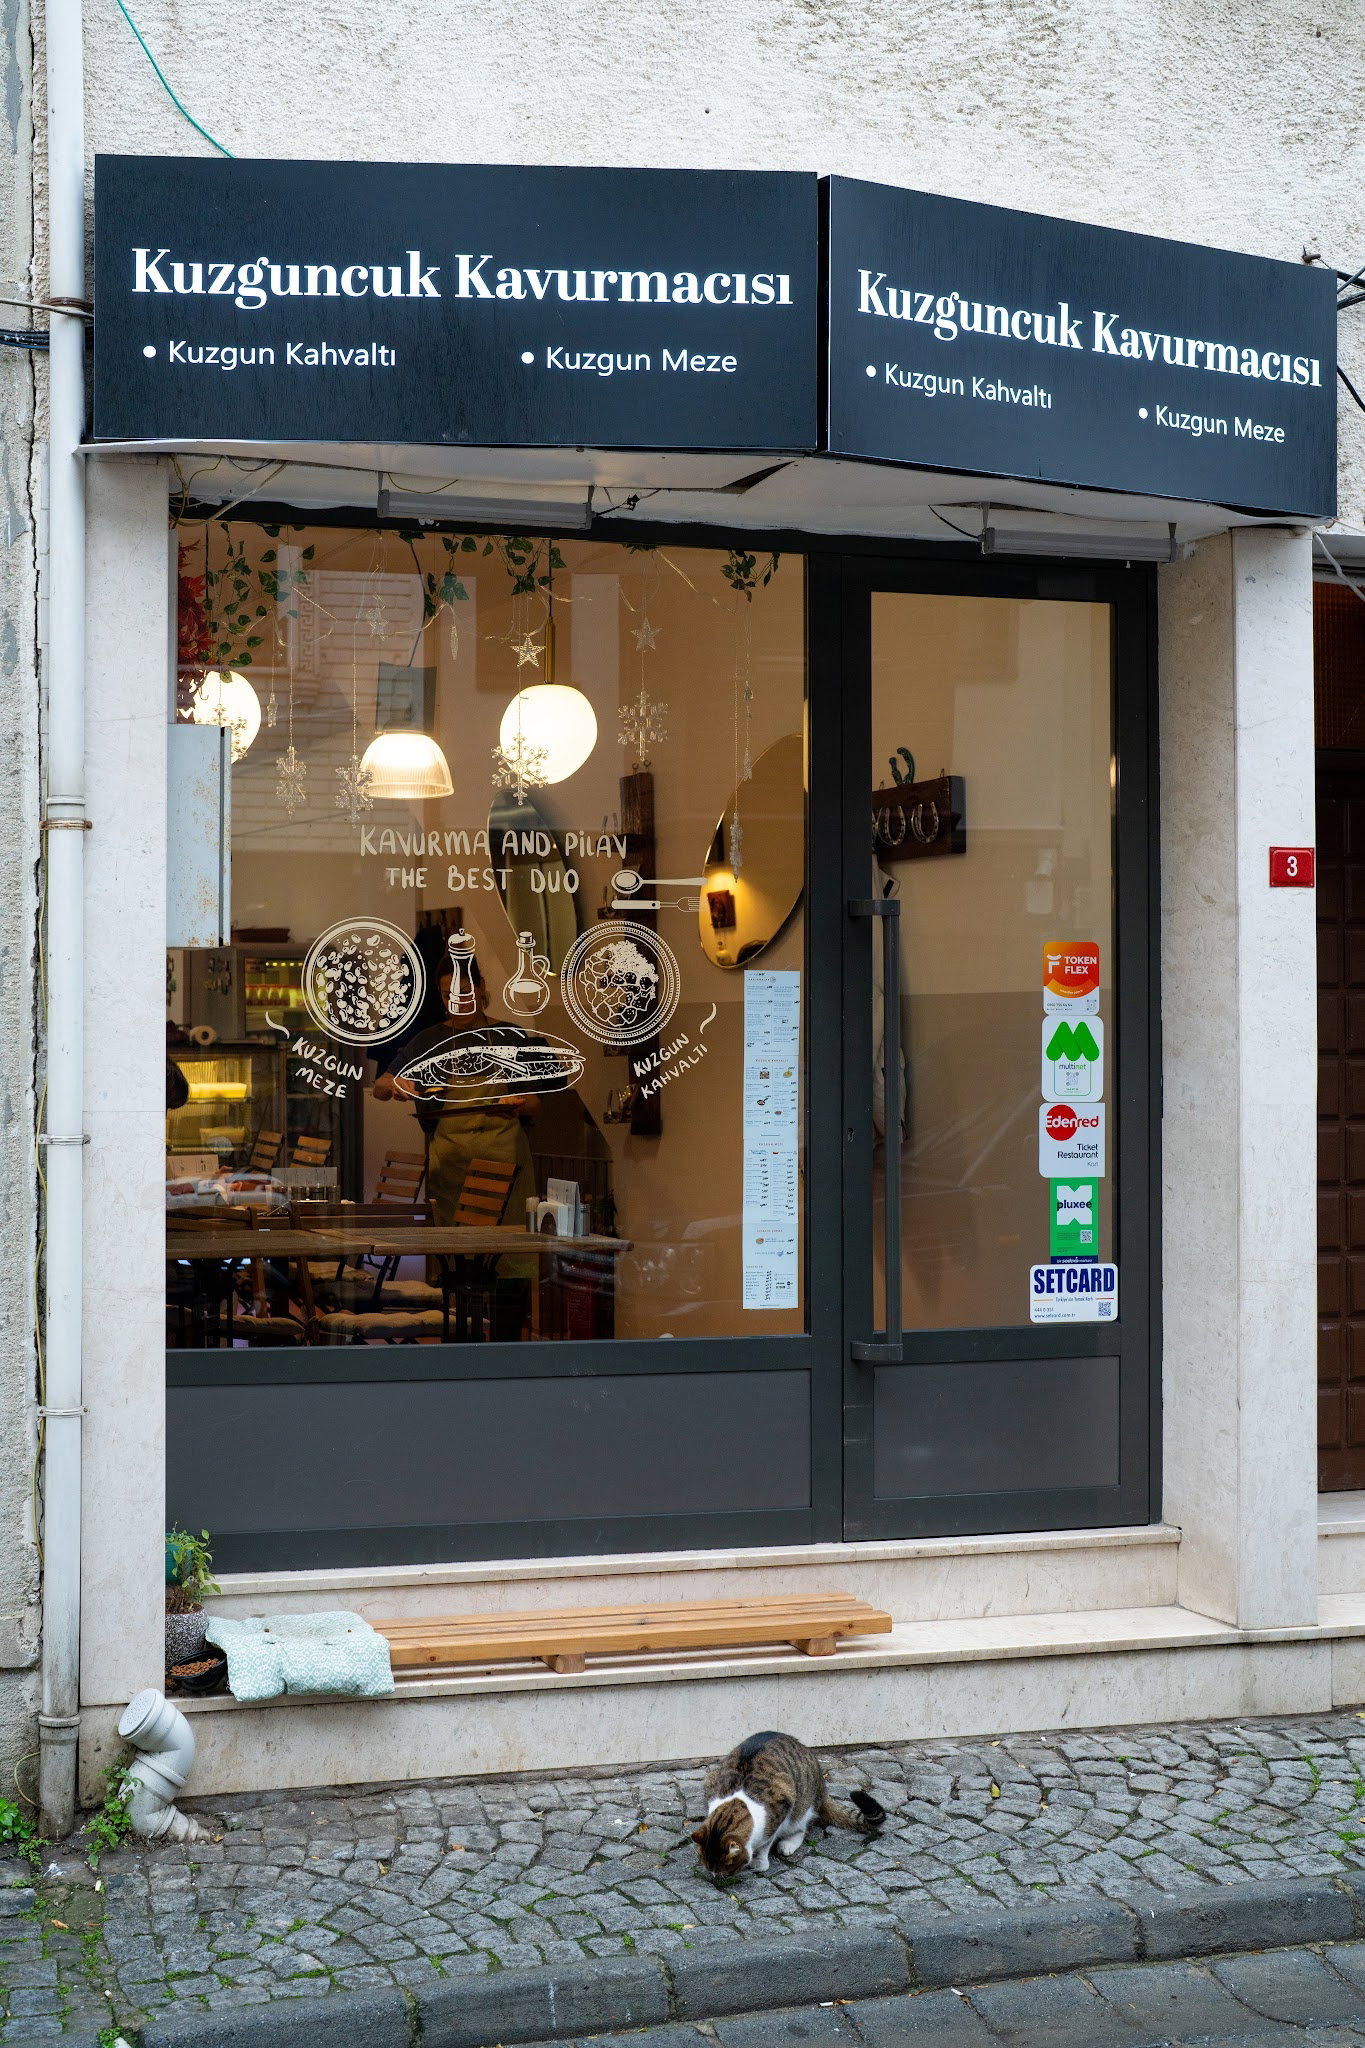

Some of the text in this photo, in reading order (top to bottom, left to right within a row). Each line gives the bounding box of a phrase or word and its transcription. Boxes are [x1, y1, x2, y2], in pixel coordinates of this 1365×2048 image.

[132, 248, 794, 310] Kuzguncuk Kavurmacısı
[858, 269, 1322, 388] Kuzguncuk Kavurmacısı
[169, 341, 396, 371] Kuzgun Kahvaltı
[546, 347, 738, 377] Kuzgun Meze
[885, 363, 1052, 409] Kuzgun Kahvaltı
[1155, 405, 1286, 444] Kuzgun Meze
[360, 825, 489, 858] KAVURMA
[501, 829, 551, 857] AND
[386, 865, 580, 894] THE BEST DUO
[1286, 856, 1298, 877] 3
[1064, 956, 1097, 965] TOKEN
[1064, 965, 1089, 975] FLEX
[291, 1036, 363, 1081] KUZGUN
[633, 1032, 690, 1078] KUZGUN
[1058, 1062, 1087, 1070] multinet
[295, 1067, 347, 1099] MEZE
[640, 1043, 708, 1100] KAHVALTI
[1046, 1115, 1099, 1128] Edenred
[1057, 1151, 1099, 1159] Restaurant
[1076, 1143, 1099, 1151] Ticket
[1056, 1199, 1093, 1212] pluxee
[1033, 1267, 1115, 1296] SETCARD
